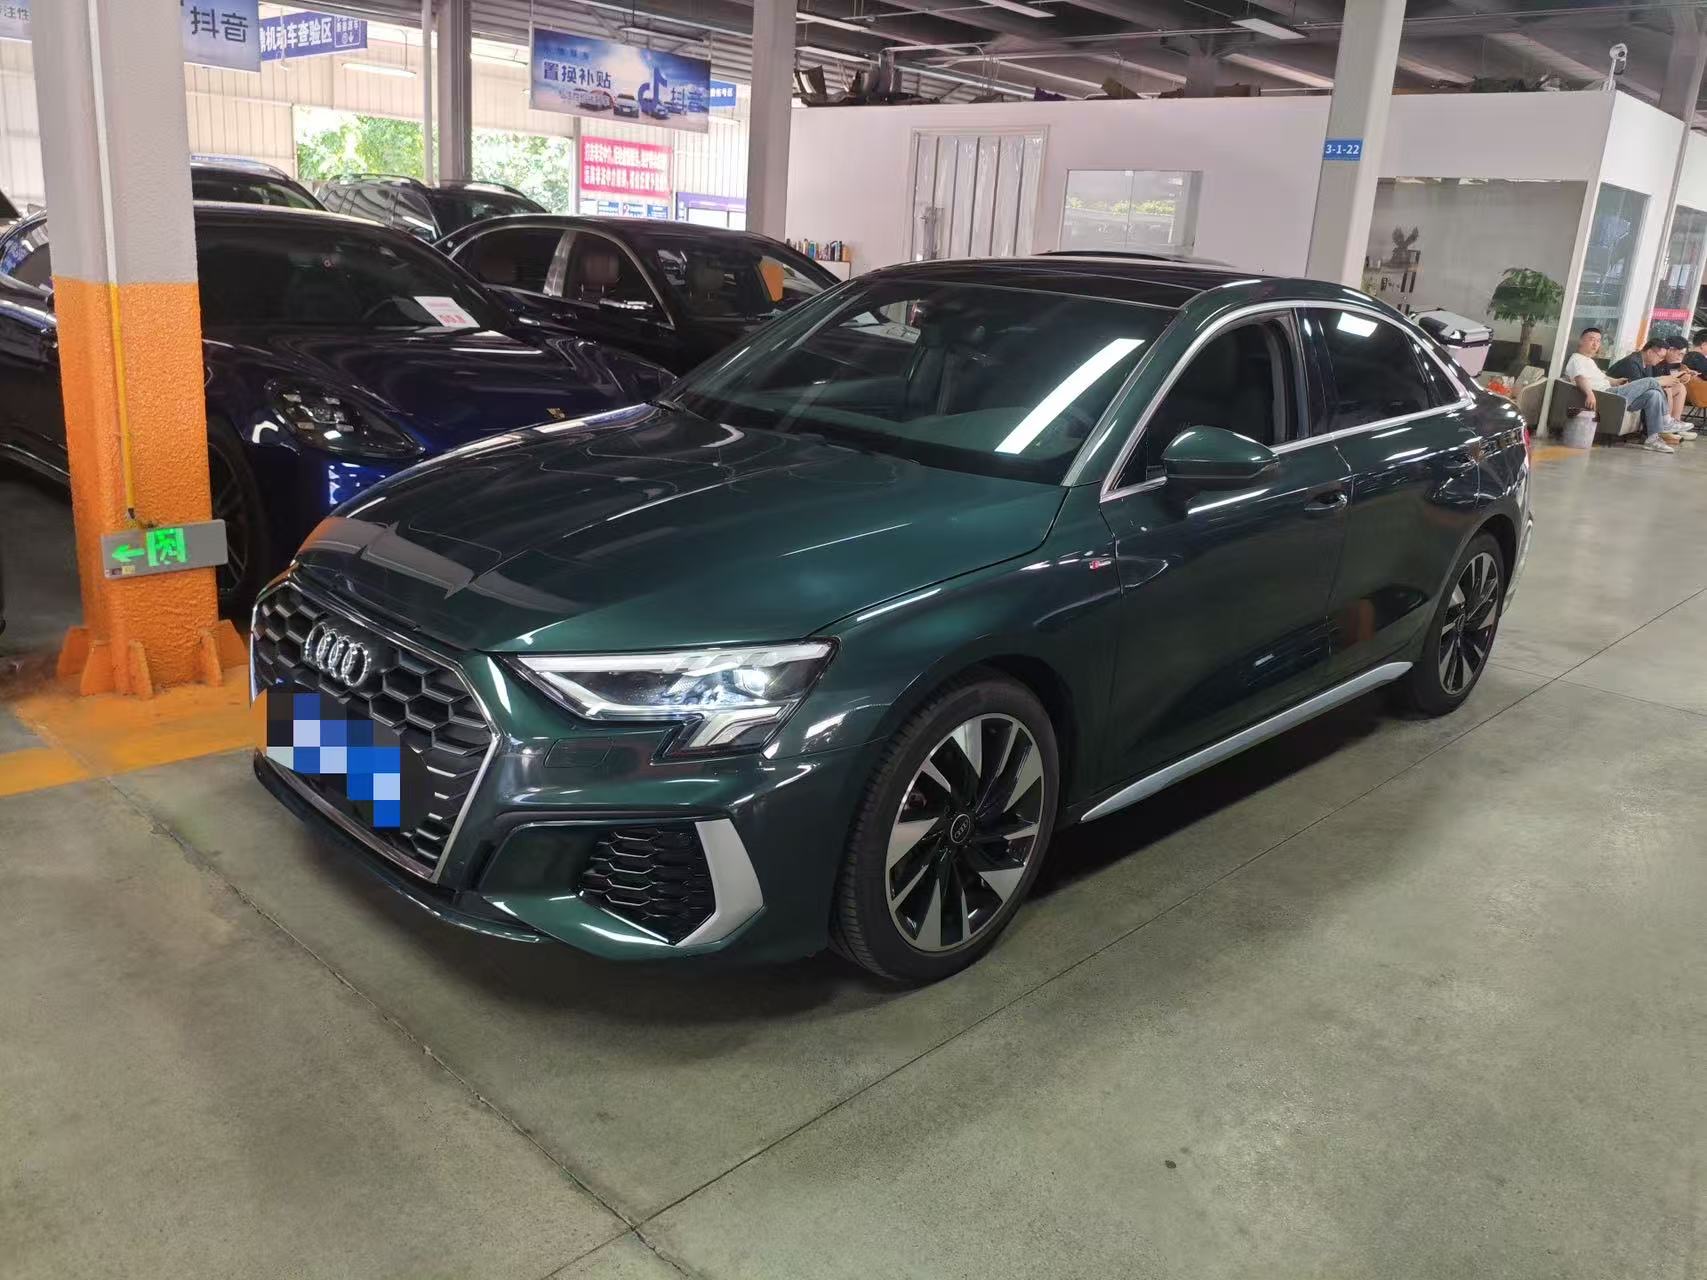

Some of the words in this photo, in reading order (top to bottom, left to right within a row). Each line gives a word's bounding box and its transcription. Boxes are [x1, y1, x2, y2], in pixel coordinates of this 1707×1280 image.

[190, 6, 249, 43] 抖音
[543, 61, 612, 89] 置换补贴
[670, 87, 704, 115] 抖音
[1325, 144, 1360, 155] 3-1-22
